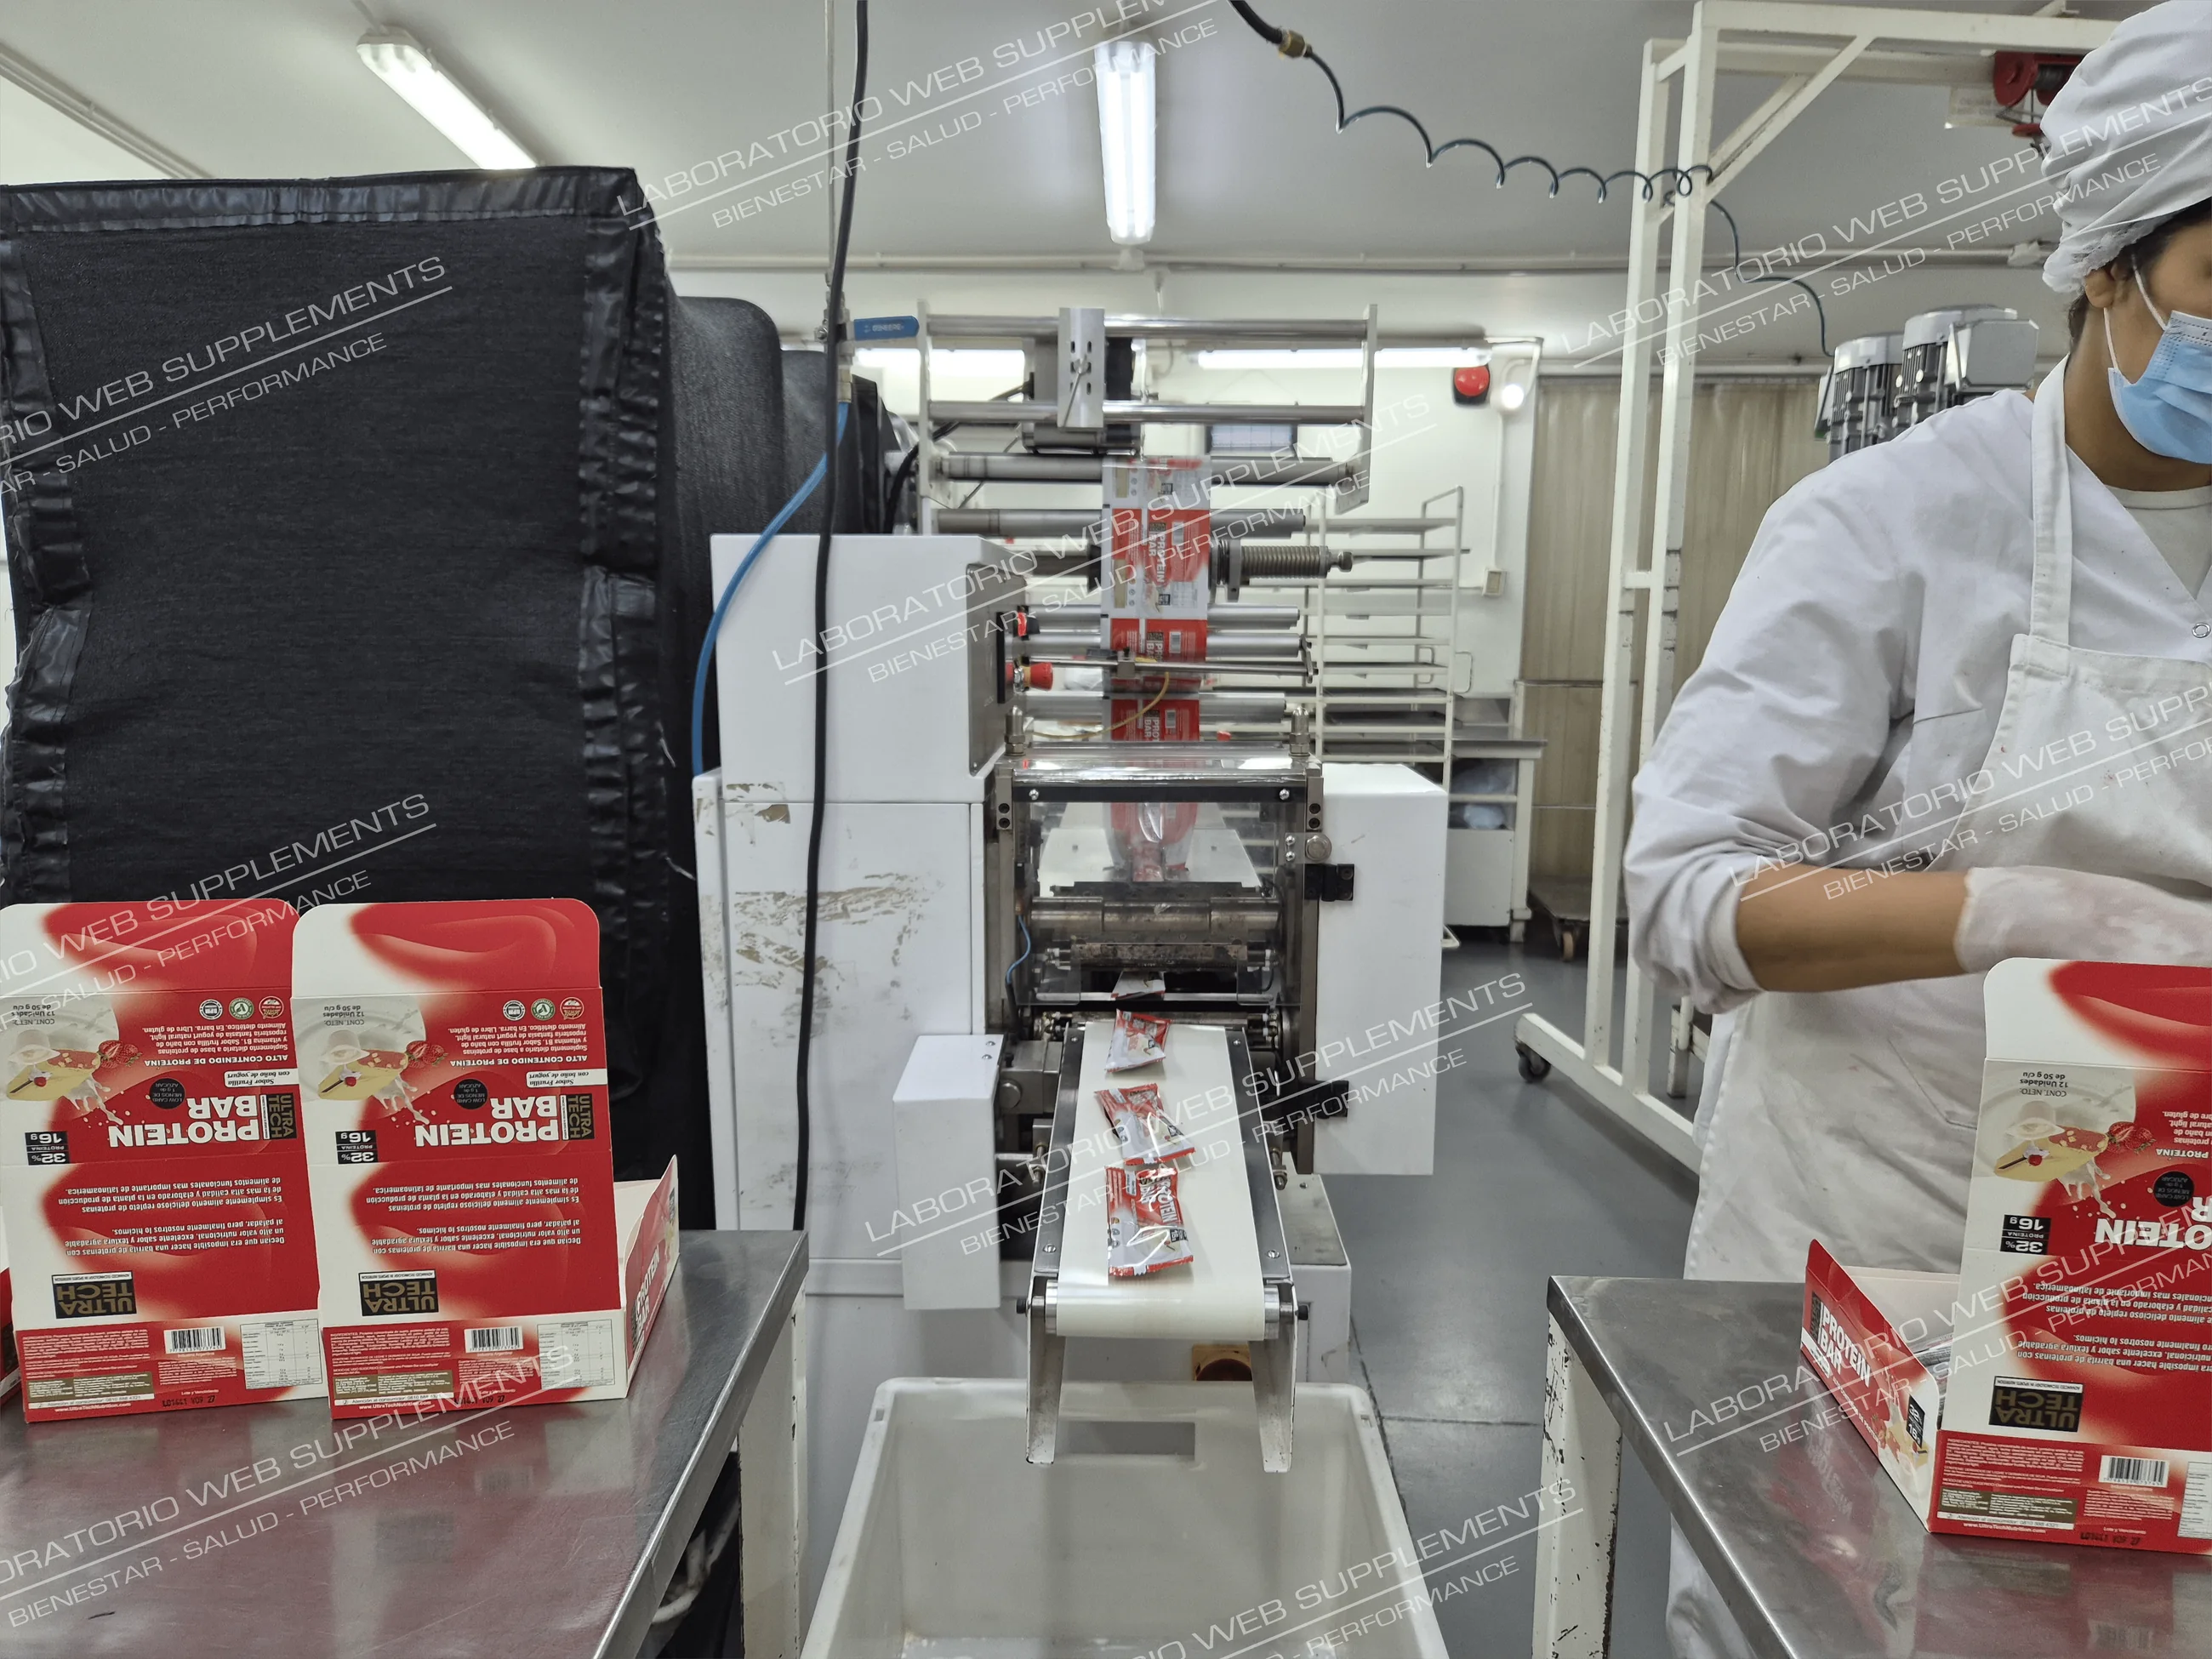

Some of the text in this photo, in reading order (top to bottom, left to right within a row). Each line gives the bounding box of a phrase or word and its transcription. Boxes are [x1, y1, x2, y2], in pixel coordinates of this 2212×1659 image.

[187, 1096, 258, 1119] BAR
[269, 1096, 282, 1137] TECH
[281, 1096, 294, 1137] ULTRA
[490, 1096, 557, 1119] BAR
[569, 1096, 579, 1138] TECH
[579, 1096, 590, 1137] ULTRA
[108, 1120, 259, 1147] PROTEIN
[415, 1120, 559, 1147] PROTEIN
[31, 1153, 66, 1163] 32%
[341, 1152, 374, 1162] 32%
[2095, 1218, 2212, 1250] OTEIN
[2005, 1240, 2043, 1252] 32%
[56, 1282, 132, 1300] TECH
[362, 1280, 434, 1298] TECH
[59, 1297, 132, 1314] ULTRA
[365, 1296, 435, 1313] ULTRA
[1821, 1328, 1843, 1375] BAR
[1822, 1307, 1871, 1388] PROTEIN
[1995, 1389, 2078, 1411] TECH
[1995, 1406, 2075, 1428] ULTRA
